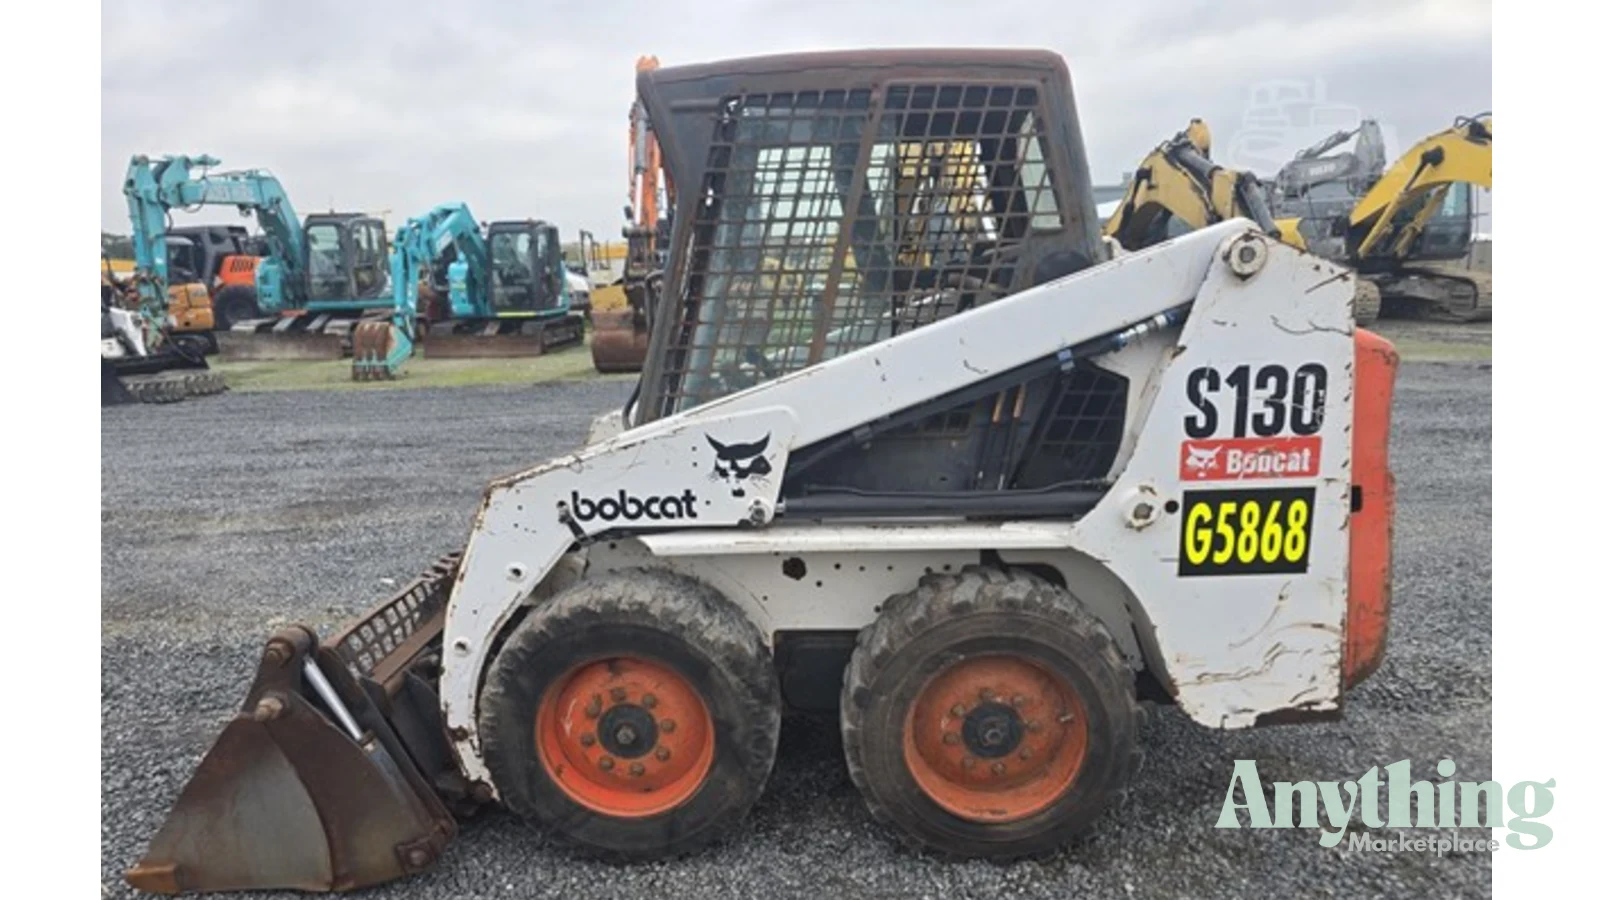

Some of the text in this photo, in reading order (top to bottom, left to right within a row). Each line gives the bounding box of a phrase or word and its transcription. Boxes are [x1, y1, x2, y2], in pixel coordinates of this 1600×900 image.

[1184, 363, 1328, 439] S130
[1226, 447, 1311, 474] Bobcat
[571, 489, 697, 521] bobcat
[1185, 499, 1308, 565] G5868
